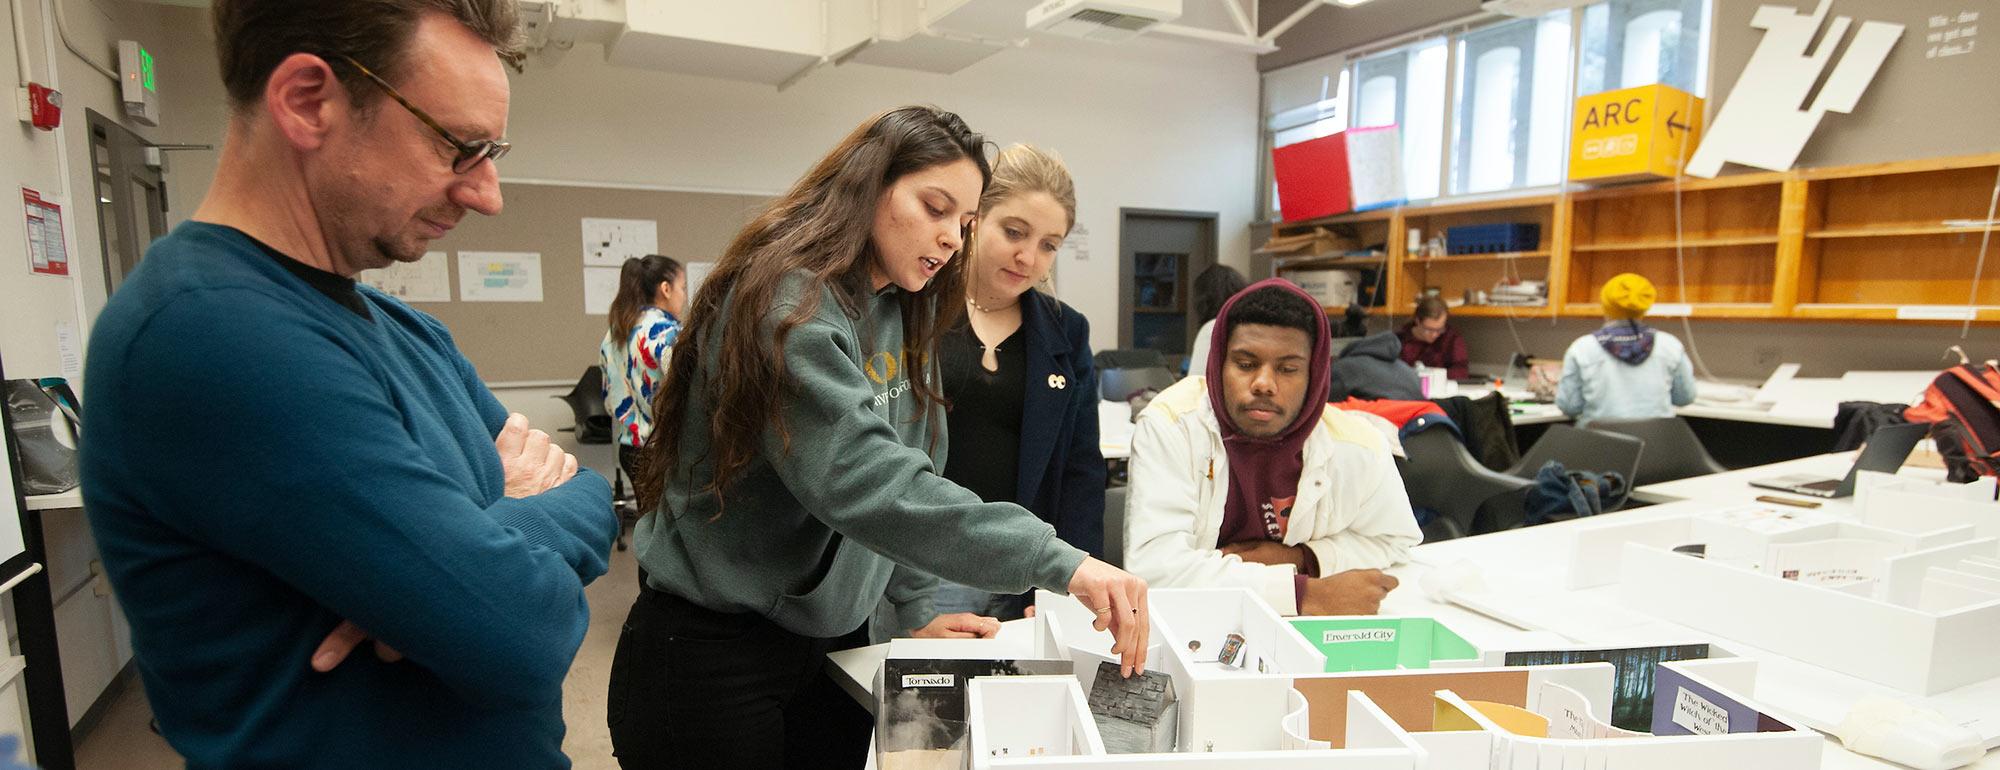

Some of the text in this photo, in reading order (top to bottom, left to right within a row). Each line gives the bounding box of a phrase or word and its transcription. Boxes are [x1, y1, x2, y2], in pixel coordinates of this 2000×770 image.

[1582, 98, 1642, 130] ARC
[1326, 630, 1394, 641] Emerald City
[906, 676, 951, 685] Tornado
[1680, 703, 1728, 734] Witch of the
[1683, 692, 1728, 724] The Wicked
